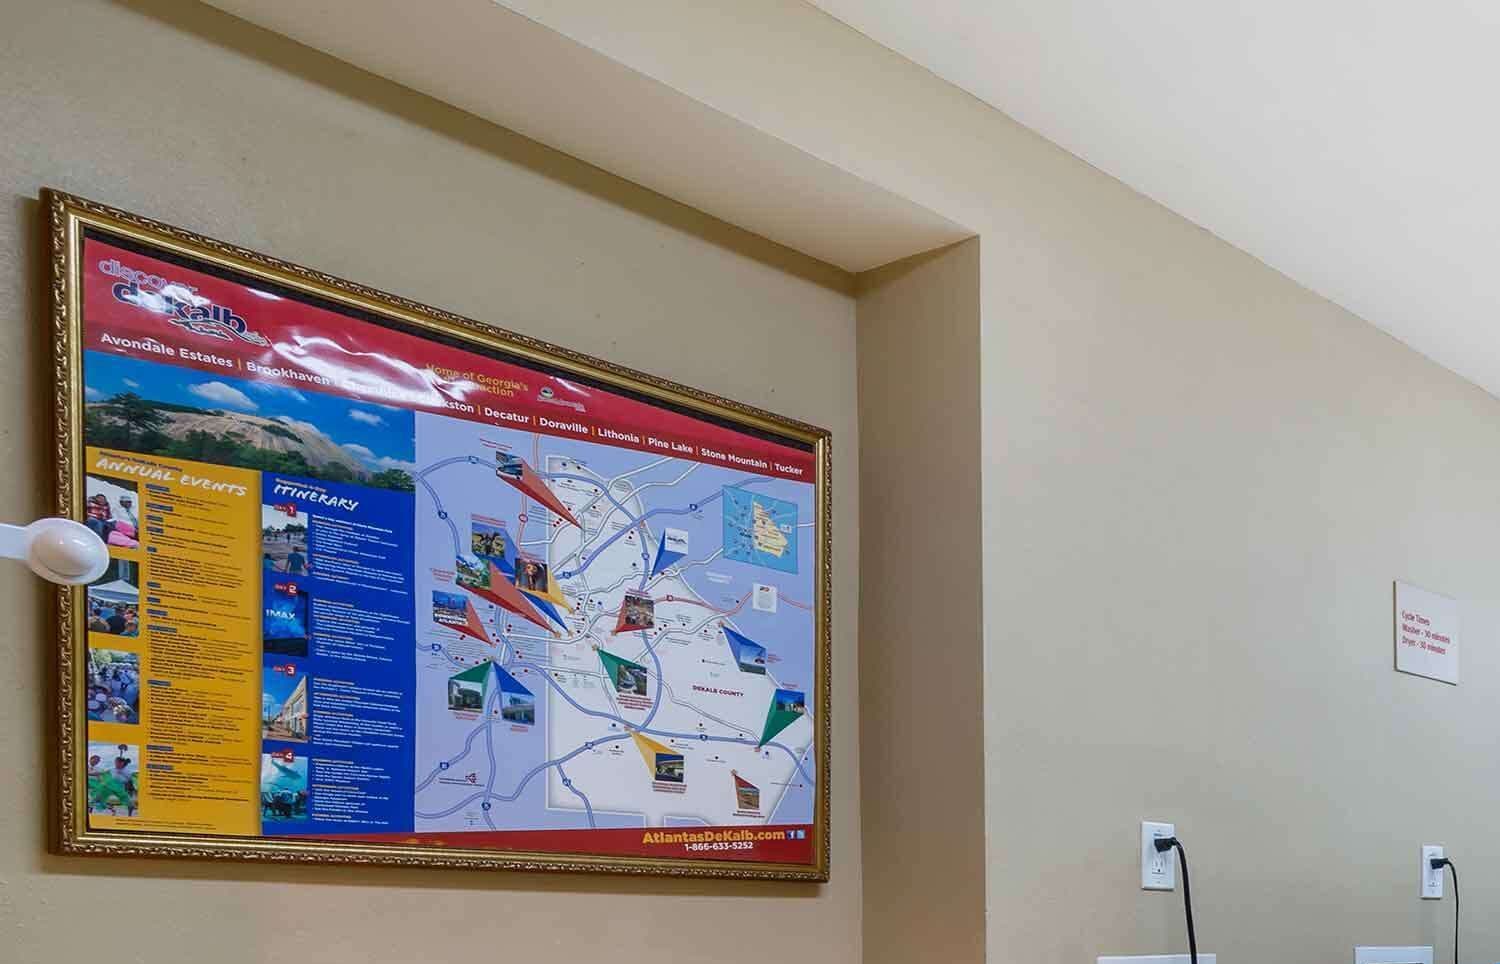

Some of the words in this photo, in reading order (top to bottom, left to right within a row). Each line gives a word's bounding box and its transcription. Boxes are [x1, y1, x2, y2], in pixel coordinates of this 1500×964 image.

[463, 372, 474, 380] of
[477, 374, 529, 392] Georgia's
[101, 333, 175, 357] Avondale
[180, 348, 233, 368] Estates
[246, 361, 331, 385] Brookhaven
[484, 407, 530, 424] Decatur
[539, 417, 589, 434] Doraville
[597, 428, 640, 444] Lithonia
[648, 437, 670, 450] Pine
[671, 442, 694, 455] Lake
[701, 448, 726, 460] Stone
[728, 452, 768, 469] Mountain
[774, 462, 804, 475] Tucker
[96, 458, 176, 481] ANNUAL
[180, 474, 248, 497] EVENTS
[274, 484, 359, 511] ITINERARY
[287, 584, 297, 594] 2
[265, 608, 296, 620] IMAX
[287, 665, 295, 675] 3
[642, 829, 785, 844] AtlantasDeKalb.com
